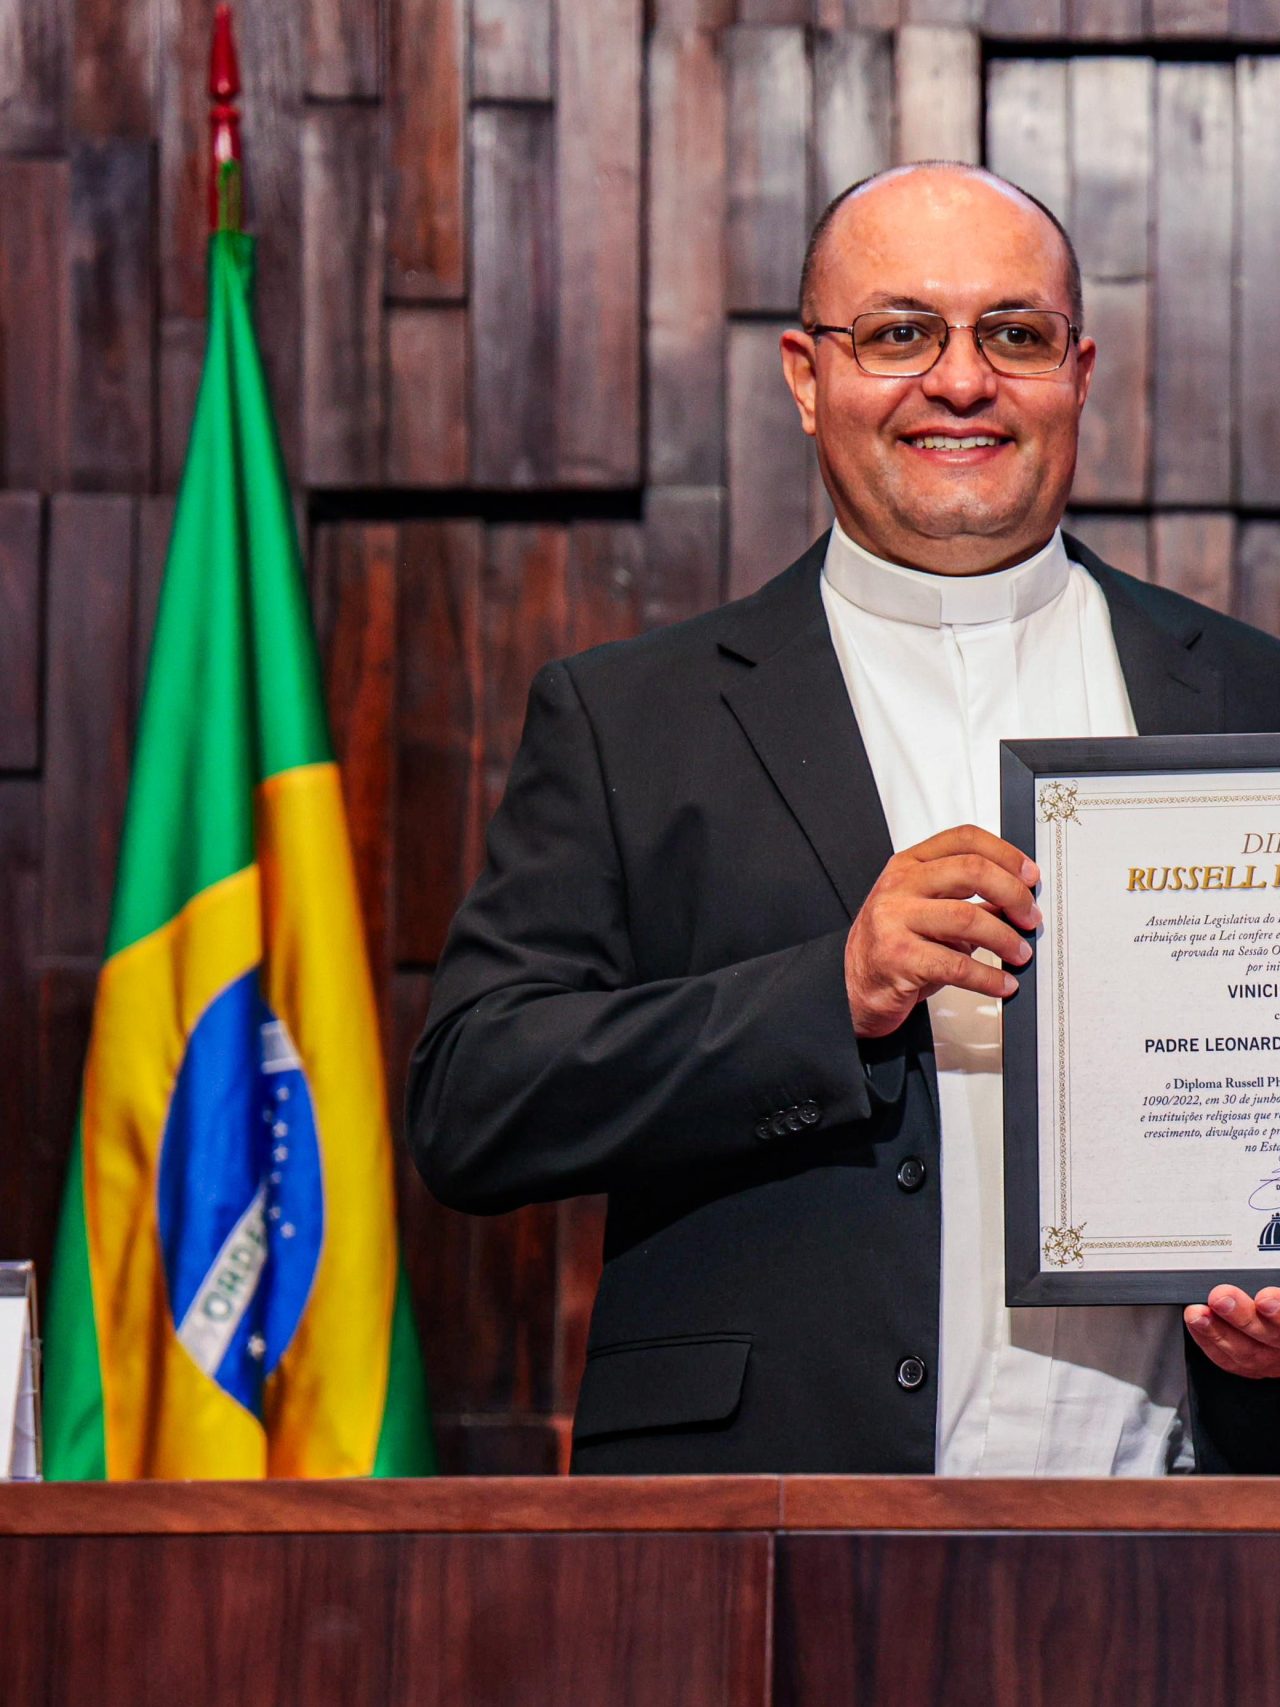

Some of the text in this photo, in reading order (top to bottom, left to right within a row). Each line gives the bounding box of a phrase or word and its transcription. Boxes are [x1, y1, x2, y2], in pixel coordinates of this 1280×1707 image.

[1126, 864, 1267, 892] RUSSELL
[1146, 914, 1200, 926] Assembleia
[1204, 913, 1260, 928] Legislativa
[1262, 912, 1274, 923] do
[1134, 930, 1186, 946] atribuições
[1190, 933, 1207, 944] que
[1219, 929, 1236, 940] Lei
[1238, 928, 1272, 943] confere
[1171, 946, 1218, 961] aprovada
[1238, 945, 1268, 956] Sessão
[1246, 964, 1263, 974] por
[1145, 1038, 1200, 1053] PADRE
[1173, 1078, 1222, 1093] Diploma
[1225, 1077, 1264, 1088] Russell
[1142, 1094, 1202, 1108] 1090/2022,
[1222, 1093, 1236, 1104] 30
[1239, 1093, 1250, 1104] de
[1250, 1092, 1280, 1107] junho
[1148, 1110, 1203, 1125] instituições
[1206, 1109, 1250, 1124] religiosas
[1254, 1112, 1271, 1123] que
[1144, 1127, 1202, 1140] crescimento,
[1206, 1125, 1259, 1141] divulgação
